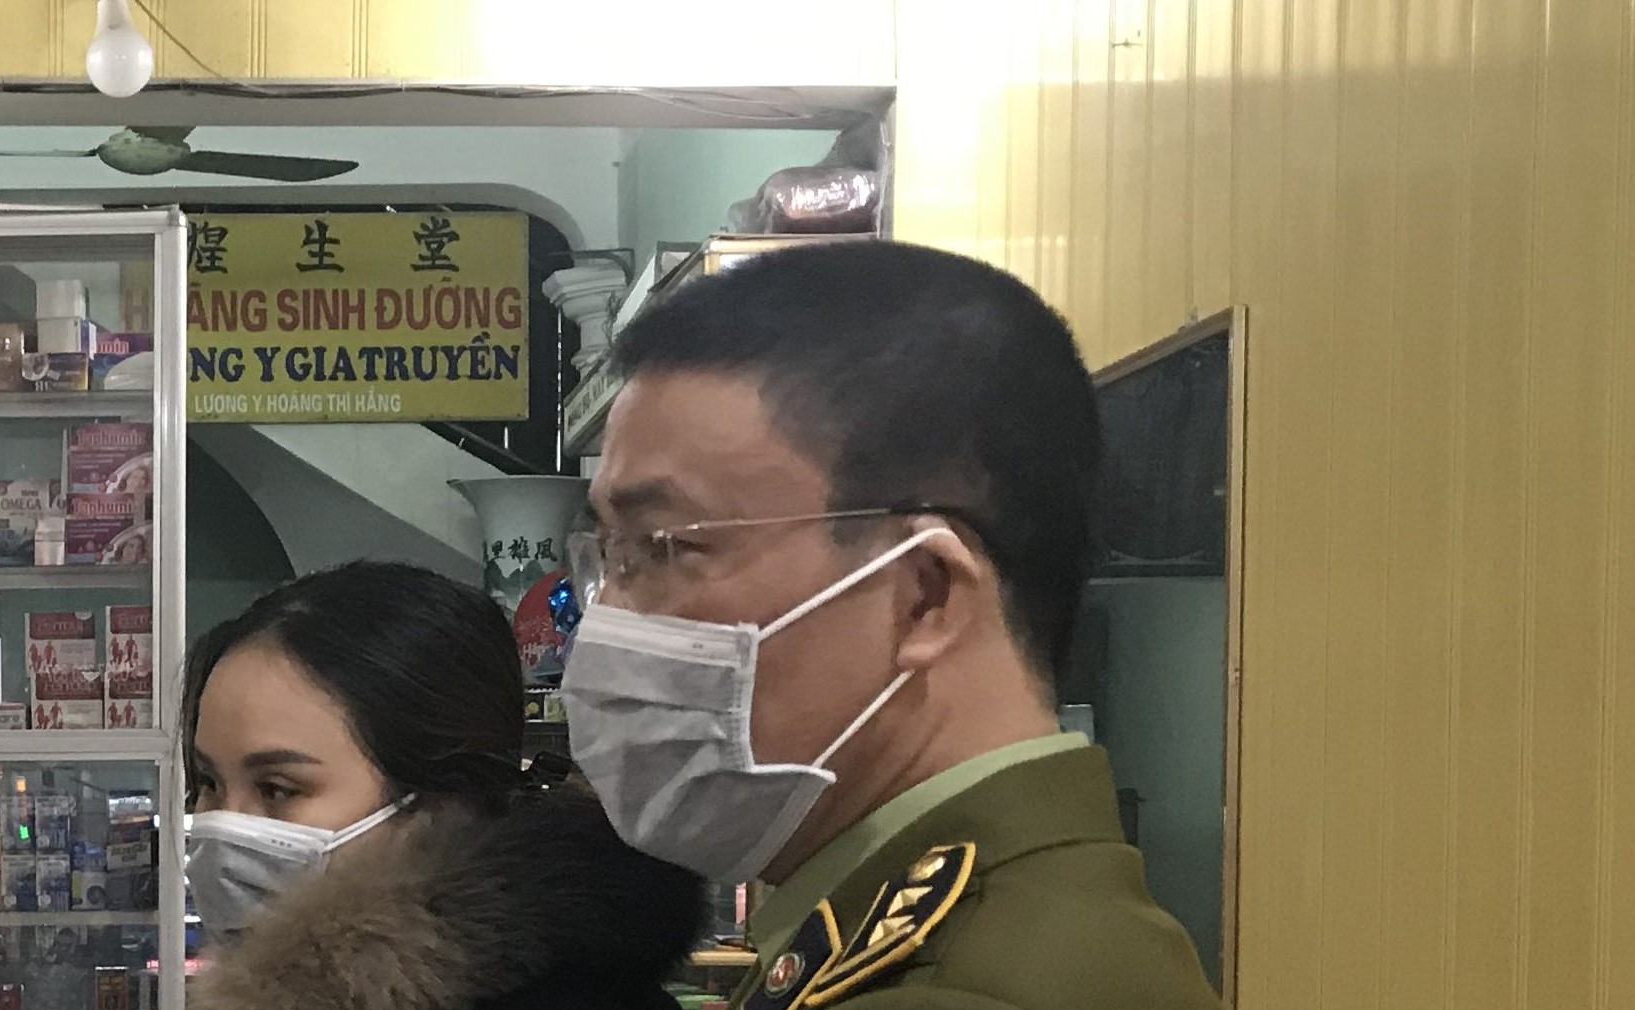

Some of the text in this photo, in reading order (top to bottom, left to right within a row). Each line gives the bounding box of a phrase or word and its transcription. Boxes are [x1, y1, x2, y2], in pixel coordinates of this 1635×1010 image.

[277, 287, 365, 332] SINH
[189, 345, 245, 383] NG
[254, 345, 281, 383] Y
[252, 394, 262, 413] Y
[0, 498, 42, 511] OMEGA
